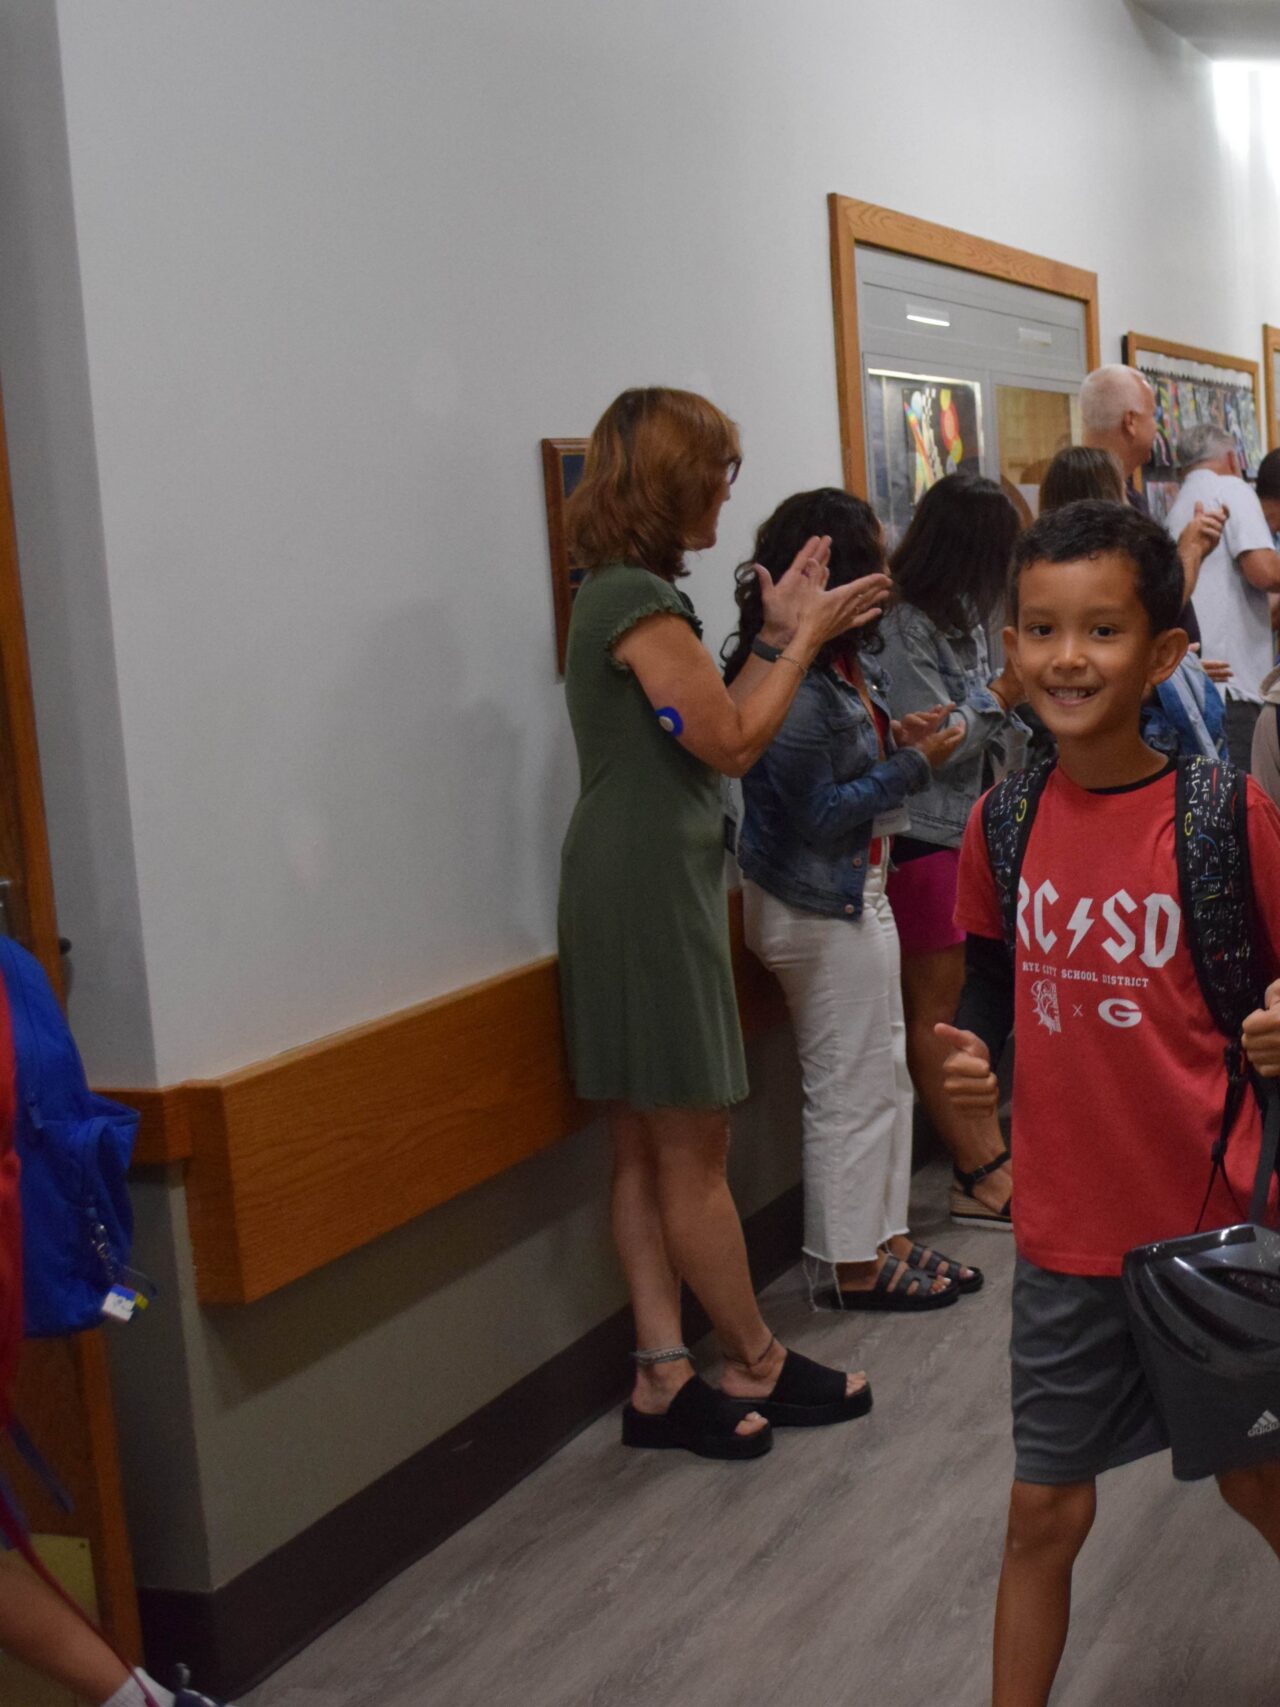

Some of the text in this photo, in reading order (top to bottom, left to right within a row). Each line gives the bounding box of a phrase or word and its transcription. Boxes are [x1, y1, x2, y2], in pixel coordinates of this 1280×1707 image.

[1022, 961, 1040, 973] RYE
[1061, 968, 1098, 982] SCHOOL
[1102, 973, 1149, 988] DISTRICT
[1098, 998, 1142, 1028] G
